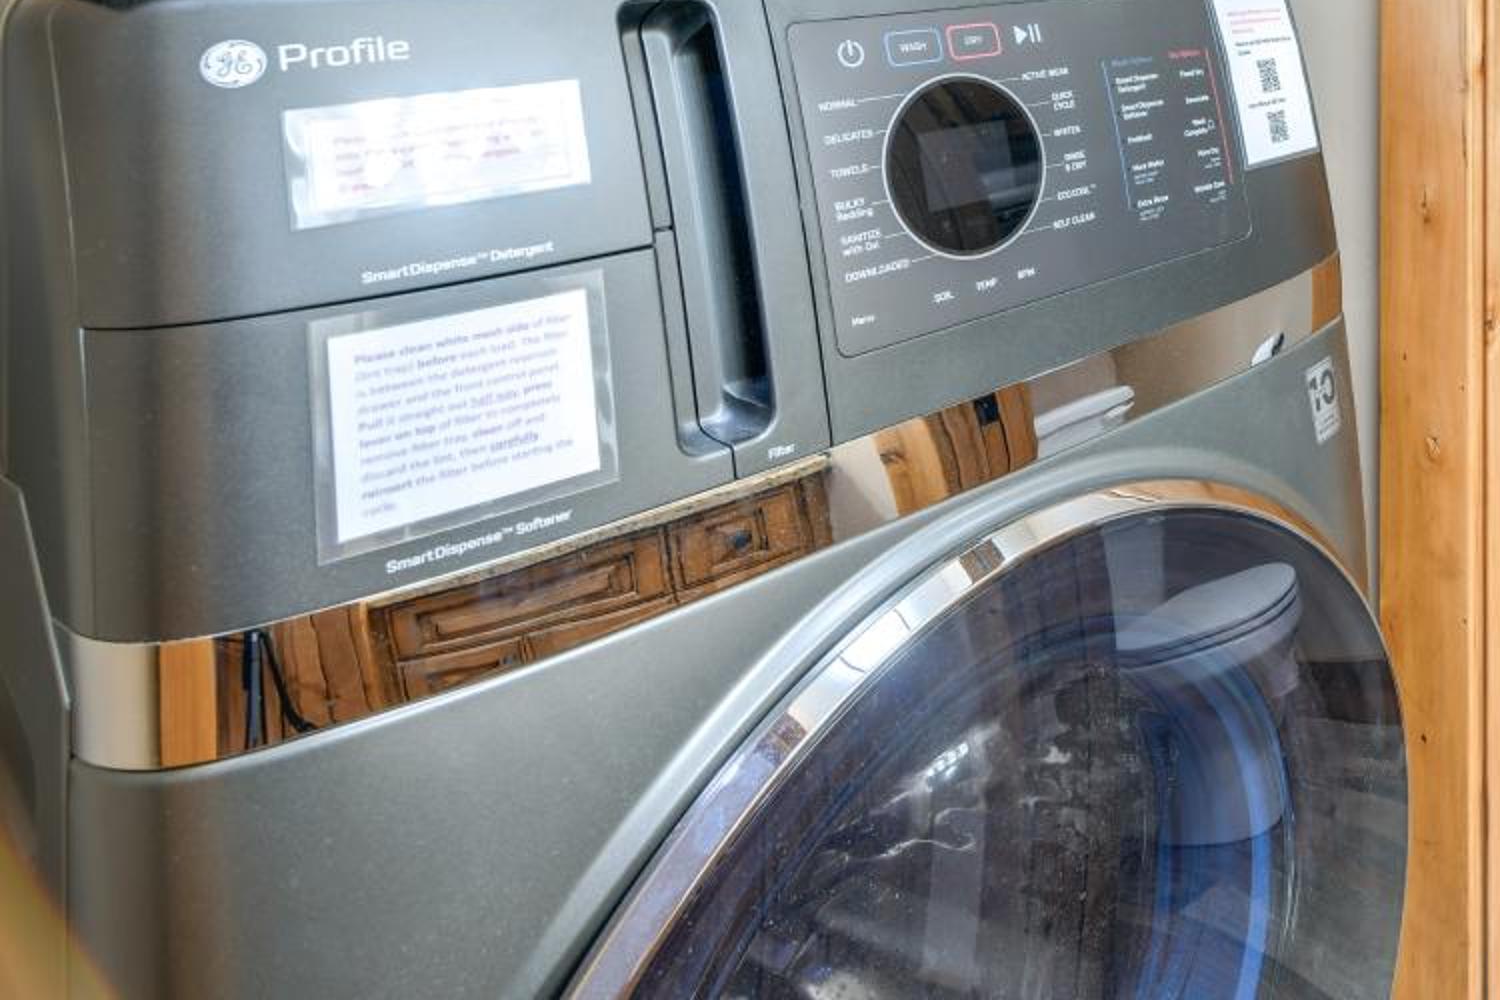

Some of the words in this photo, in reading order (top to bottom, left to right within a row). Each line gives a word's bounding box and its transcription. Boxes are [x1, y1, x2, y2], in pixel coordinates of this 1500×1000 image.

[278, 35, 411, 72] Profile
[898, 41, 928, 54] WASH
[818, 98, 857, 112] NORMAL
[824, 128, 874, 146] DELICATES
[830, 163, 870, 180] TOWELS
[490, 240, 554, 263] Detergent
[845, 258, 911, 283] DOWNLOADED
[975, 277, 998, 291] TEMP
[515, 508, 574, 535] Softener
